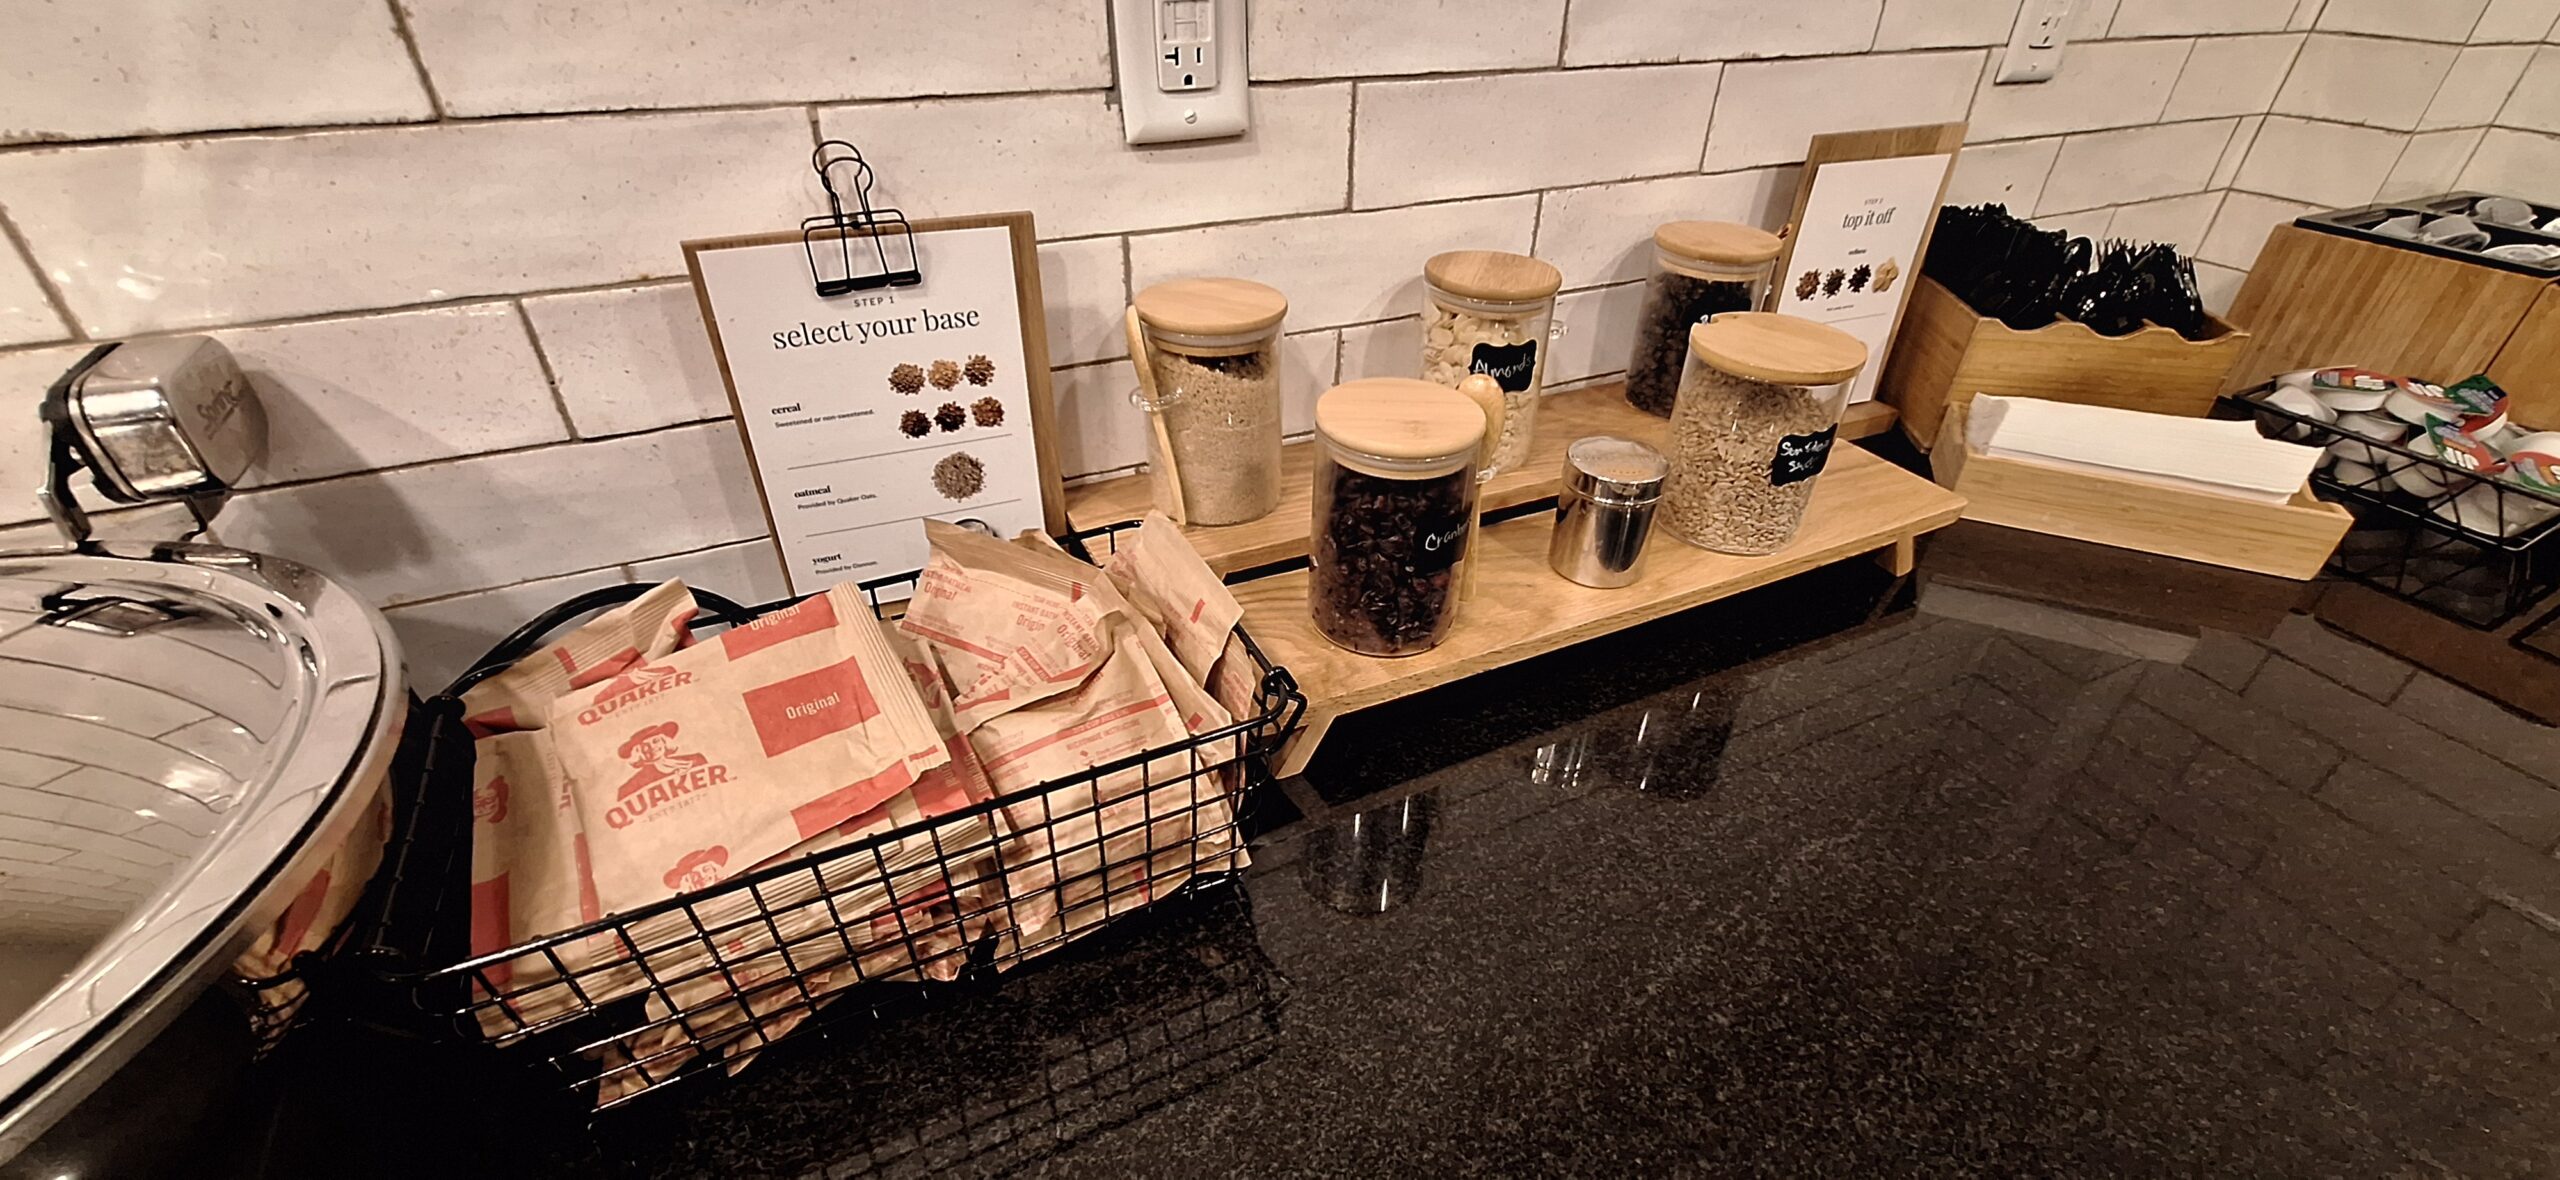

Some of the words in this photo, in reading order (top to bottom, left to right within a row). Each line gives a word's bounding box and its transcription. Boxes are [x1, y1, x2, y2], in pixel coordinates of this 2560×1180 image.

[1842, 214, 1863, 230] top
[1864, 210, 1875, 226] it
[1876, 207, 1897, 224] off
[854, 298, 885, 308] STEP
[889, 296, 895, 305] 1
[773, 320, 853, 350] select
[857, 317, 917, 345] your
[923, 308, 980, 333] base
[1473, 353, 1532, 378] Almonds
[771, 403, 802, 415] cereal
[775, 417, 813, 429] Sweetened
[794, 485, 832, 498] oatmeal
[797, 501, 827, 510] Provided
[837, 496, 860, 504] Quaker
[812, 553, 842, 565] yogurt
[815, 565, 843, 575] Provided
[923, 582, 957, 601] Original
[749, 605, 801, 631] Original
[1056, 623, 1092, 661] Original
[577, 671, 693, 727] QUAKER
[786, 691, 841, 720] Original
[604, 764, 731, 831] QUAKER
